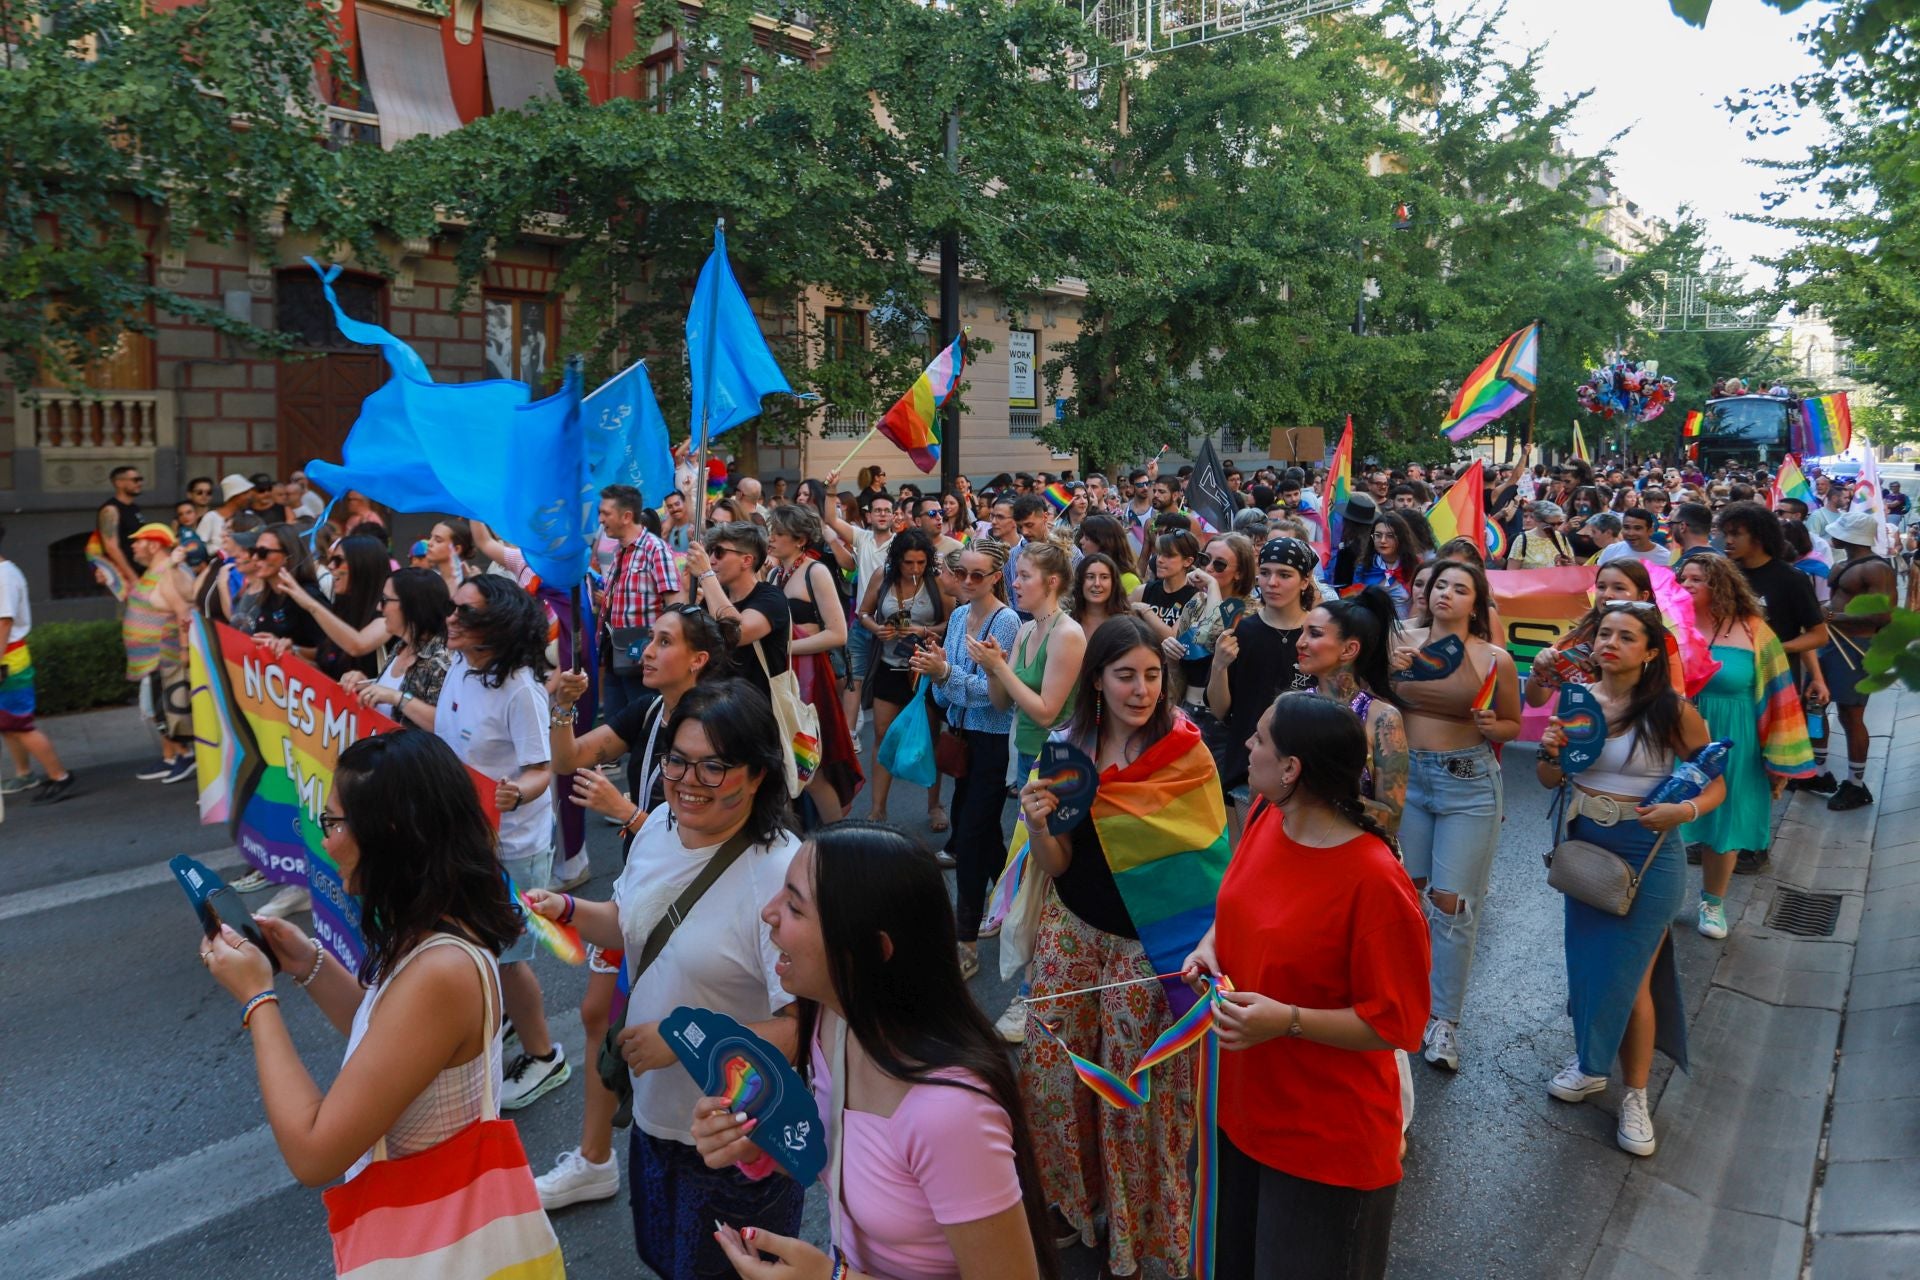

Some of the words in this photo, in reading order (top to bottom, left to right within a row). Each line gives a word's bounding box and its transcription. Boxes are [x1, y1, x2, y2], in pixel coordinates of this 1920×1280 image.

[1010, 350, 1031, 360] WORK
[1014, 365, 1027, 374] INN
[243, 655, 288, 711] NO
[286, 677, 316, 736] ES
[270, 854, 306, 876] POR
